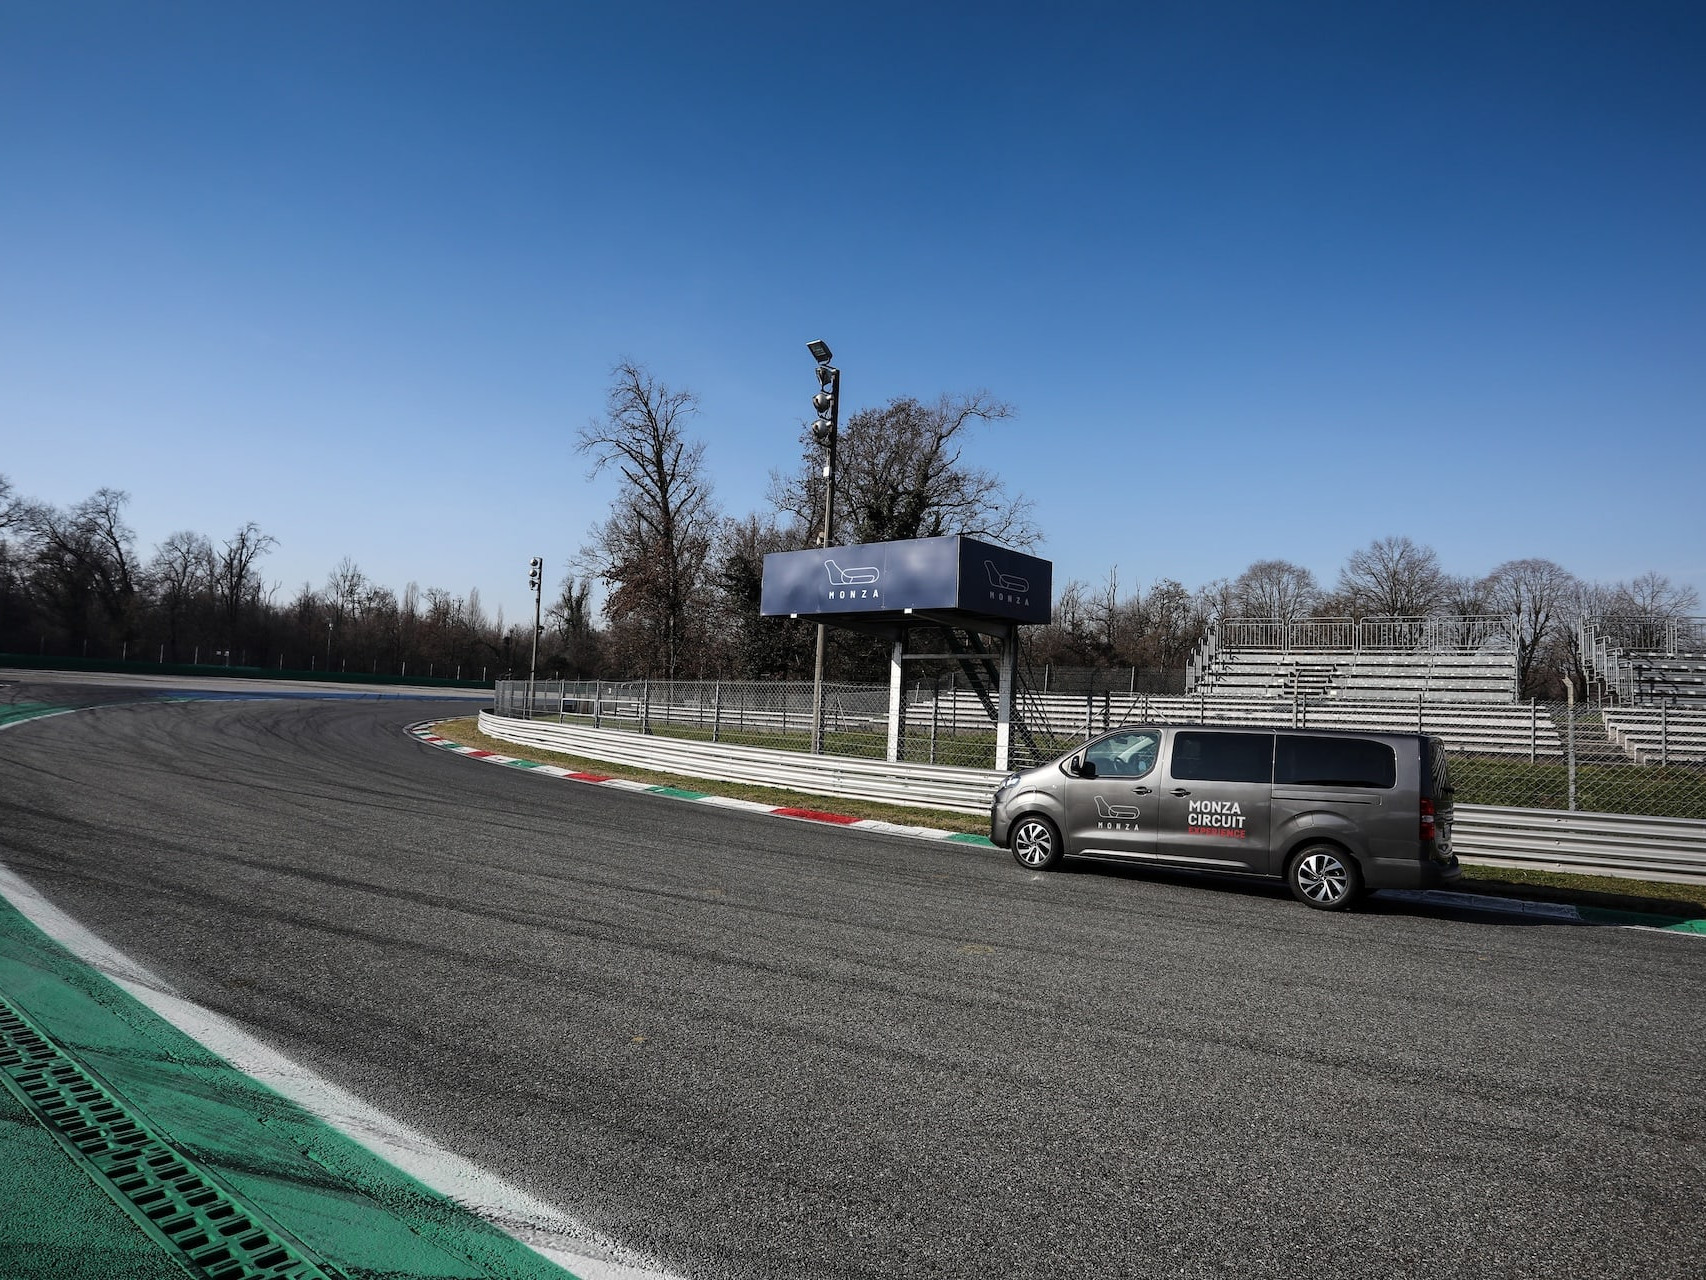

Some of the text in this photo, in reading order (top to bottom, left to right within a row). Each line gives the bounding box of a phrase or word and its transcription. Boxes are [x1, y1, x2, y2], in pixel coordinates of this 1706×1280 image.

[828, 589, 879, 600] MONZA
[989, 591, 1030, 606] MONZA
[1188, 800, 1241, 814] MONZA
[1097, 821, 1139, 831] MONZA
[1187, 813, 1246, 828] CIRCUIT
[1188, 826, 1246, 839] EXPERIENCE
